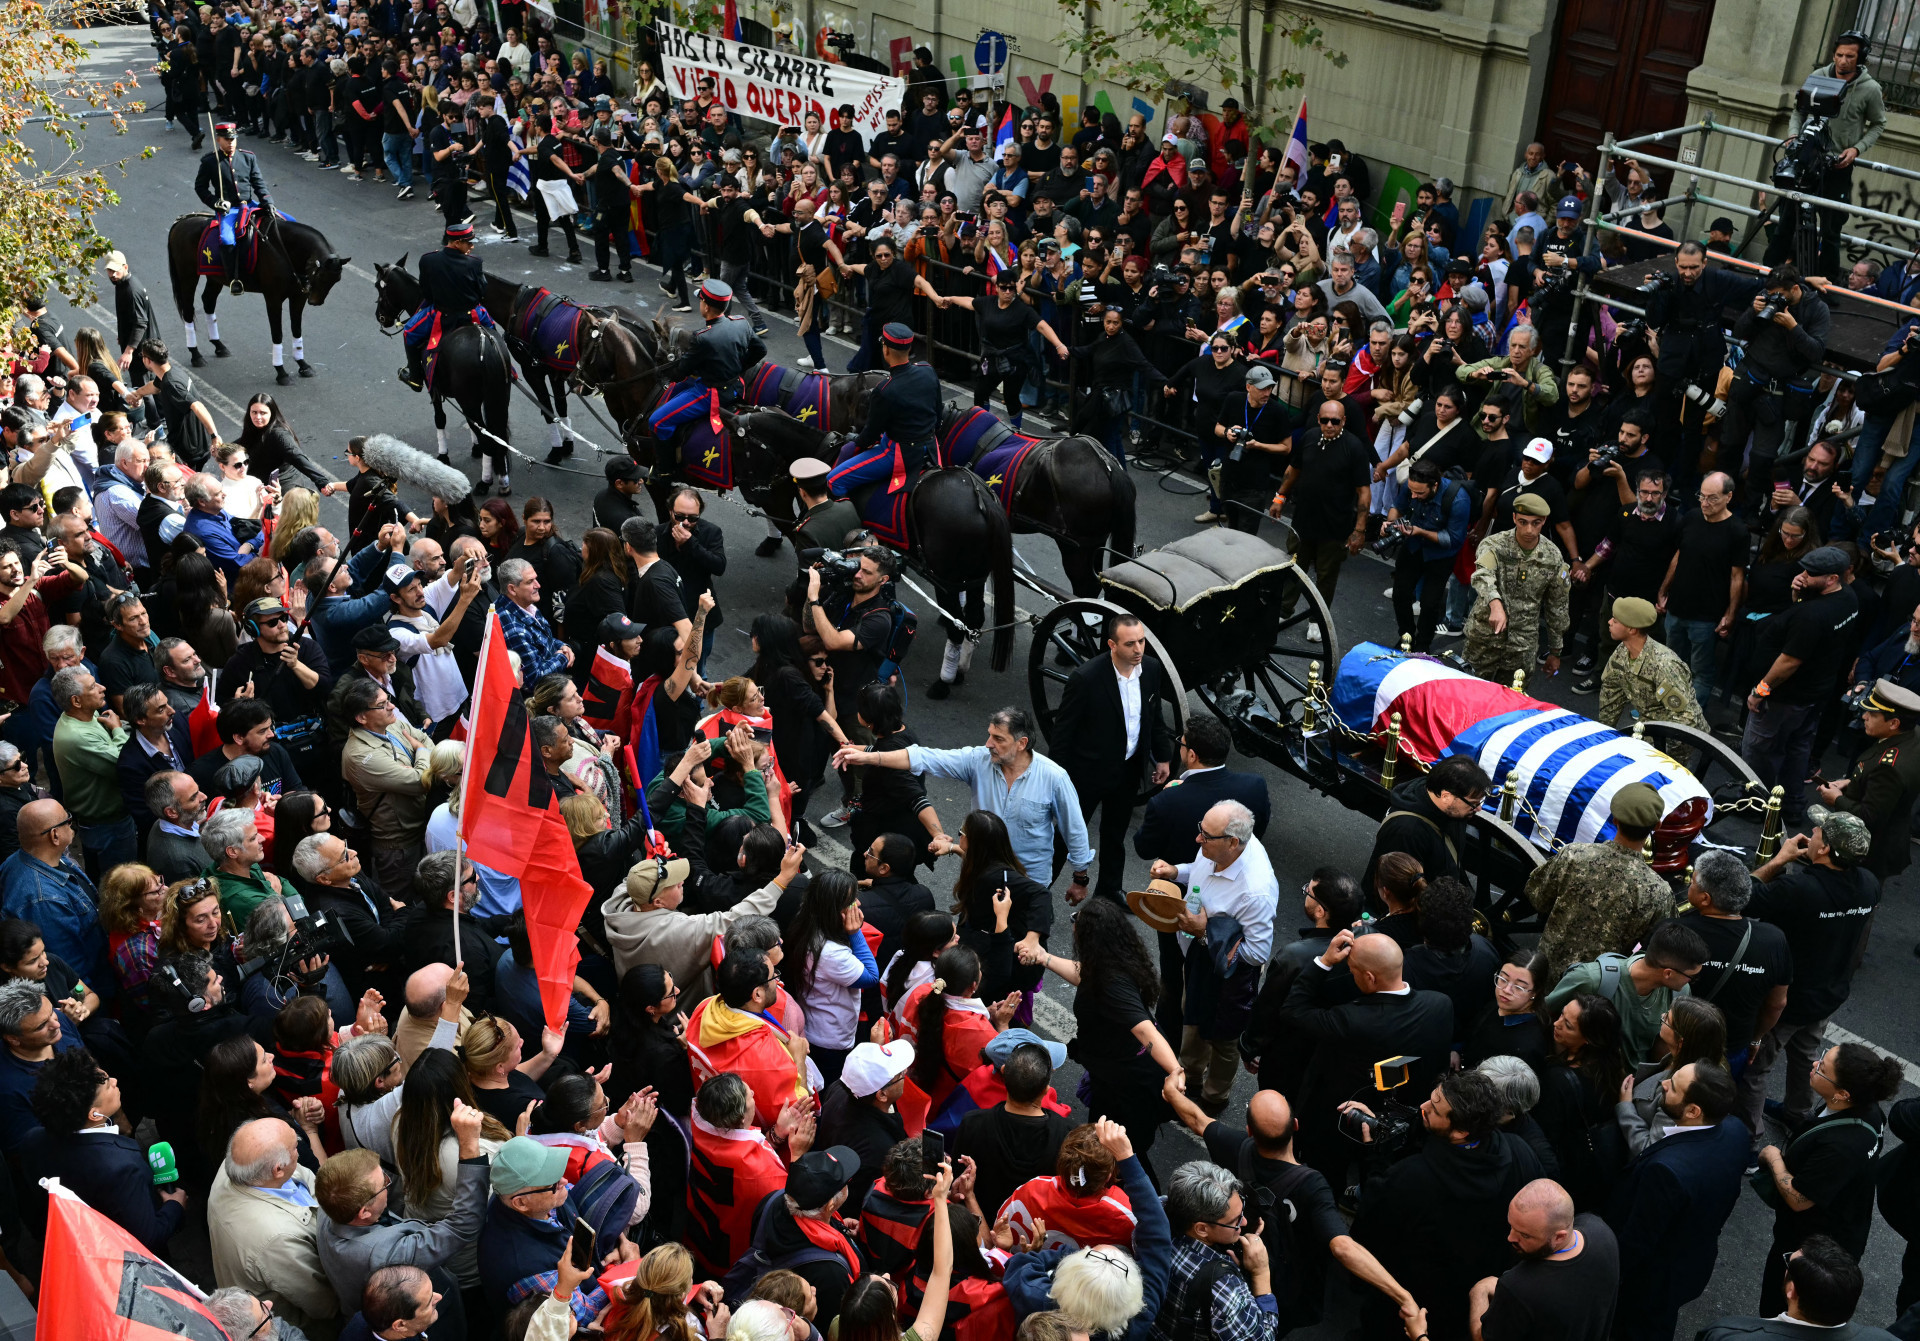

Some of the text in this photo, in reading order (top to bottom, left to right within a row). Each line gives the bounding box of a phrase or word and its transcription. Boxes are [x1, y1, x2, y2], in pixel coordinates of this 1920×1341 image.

[656, 21, 733, 70] HASTA
[1710, 960, 1724, 969] voy,
[1742, 963, 1766, 975] llegando
